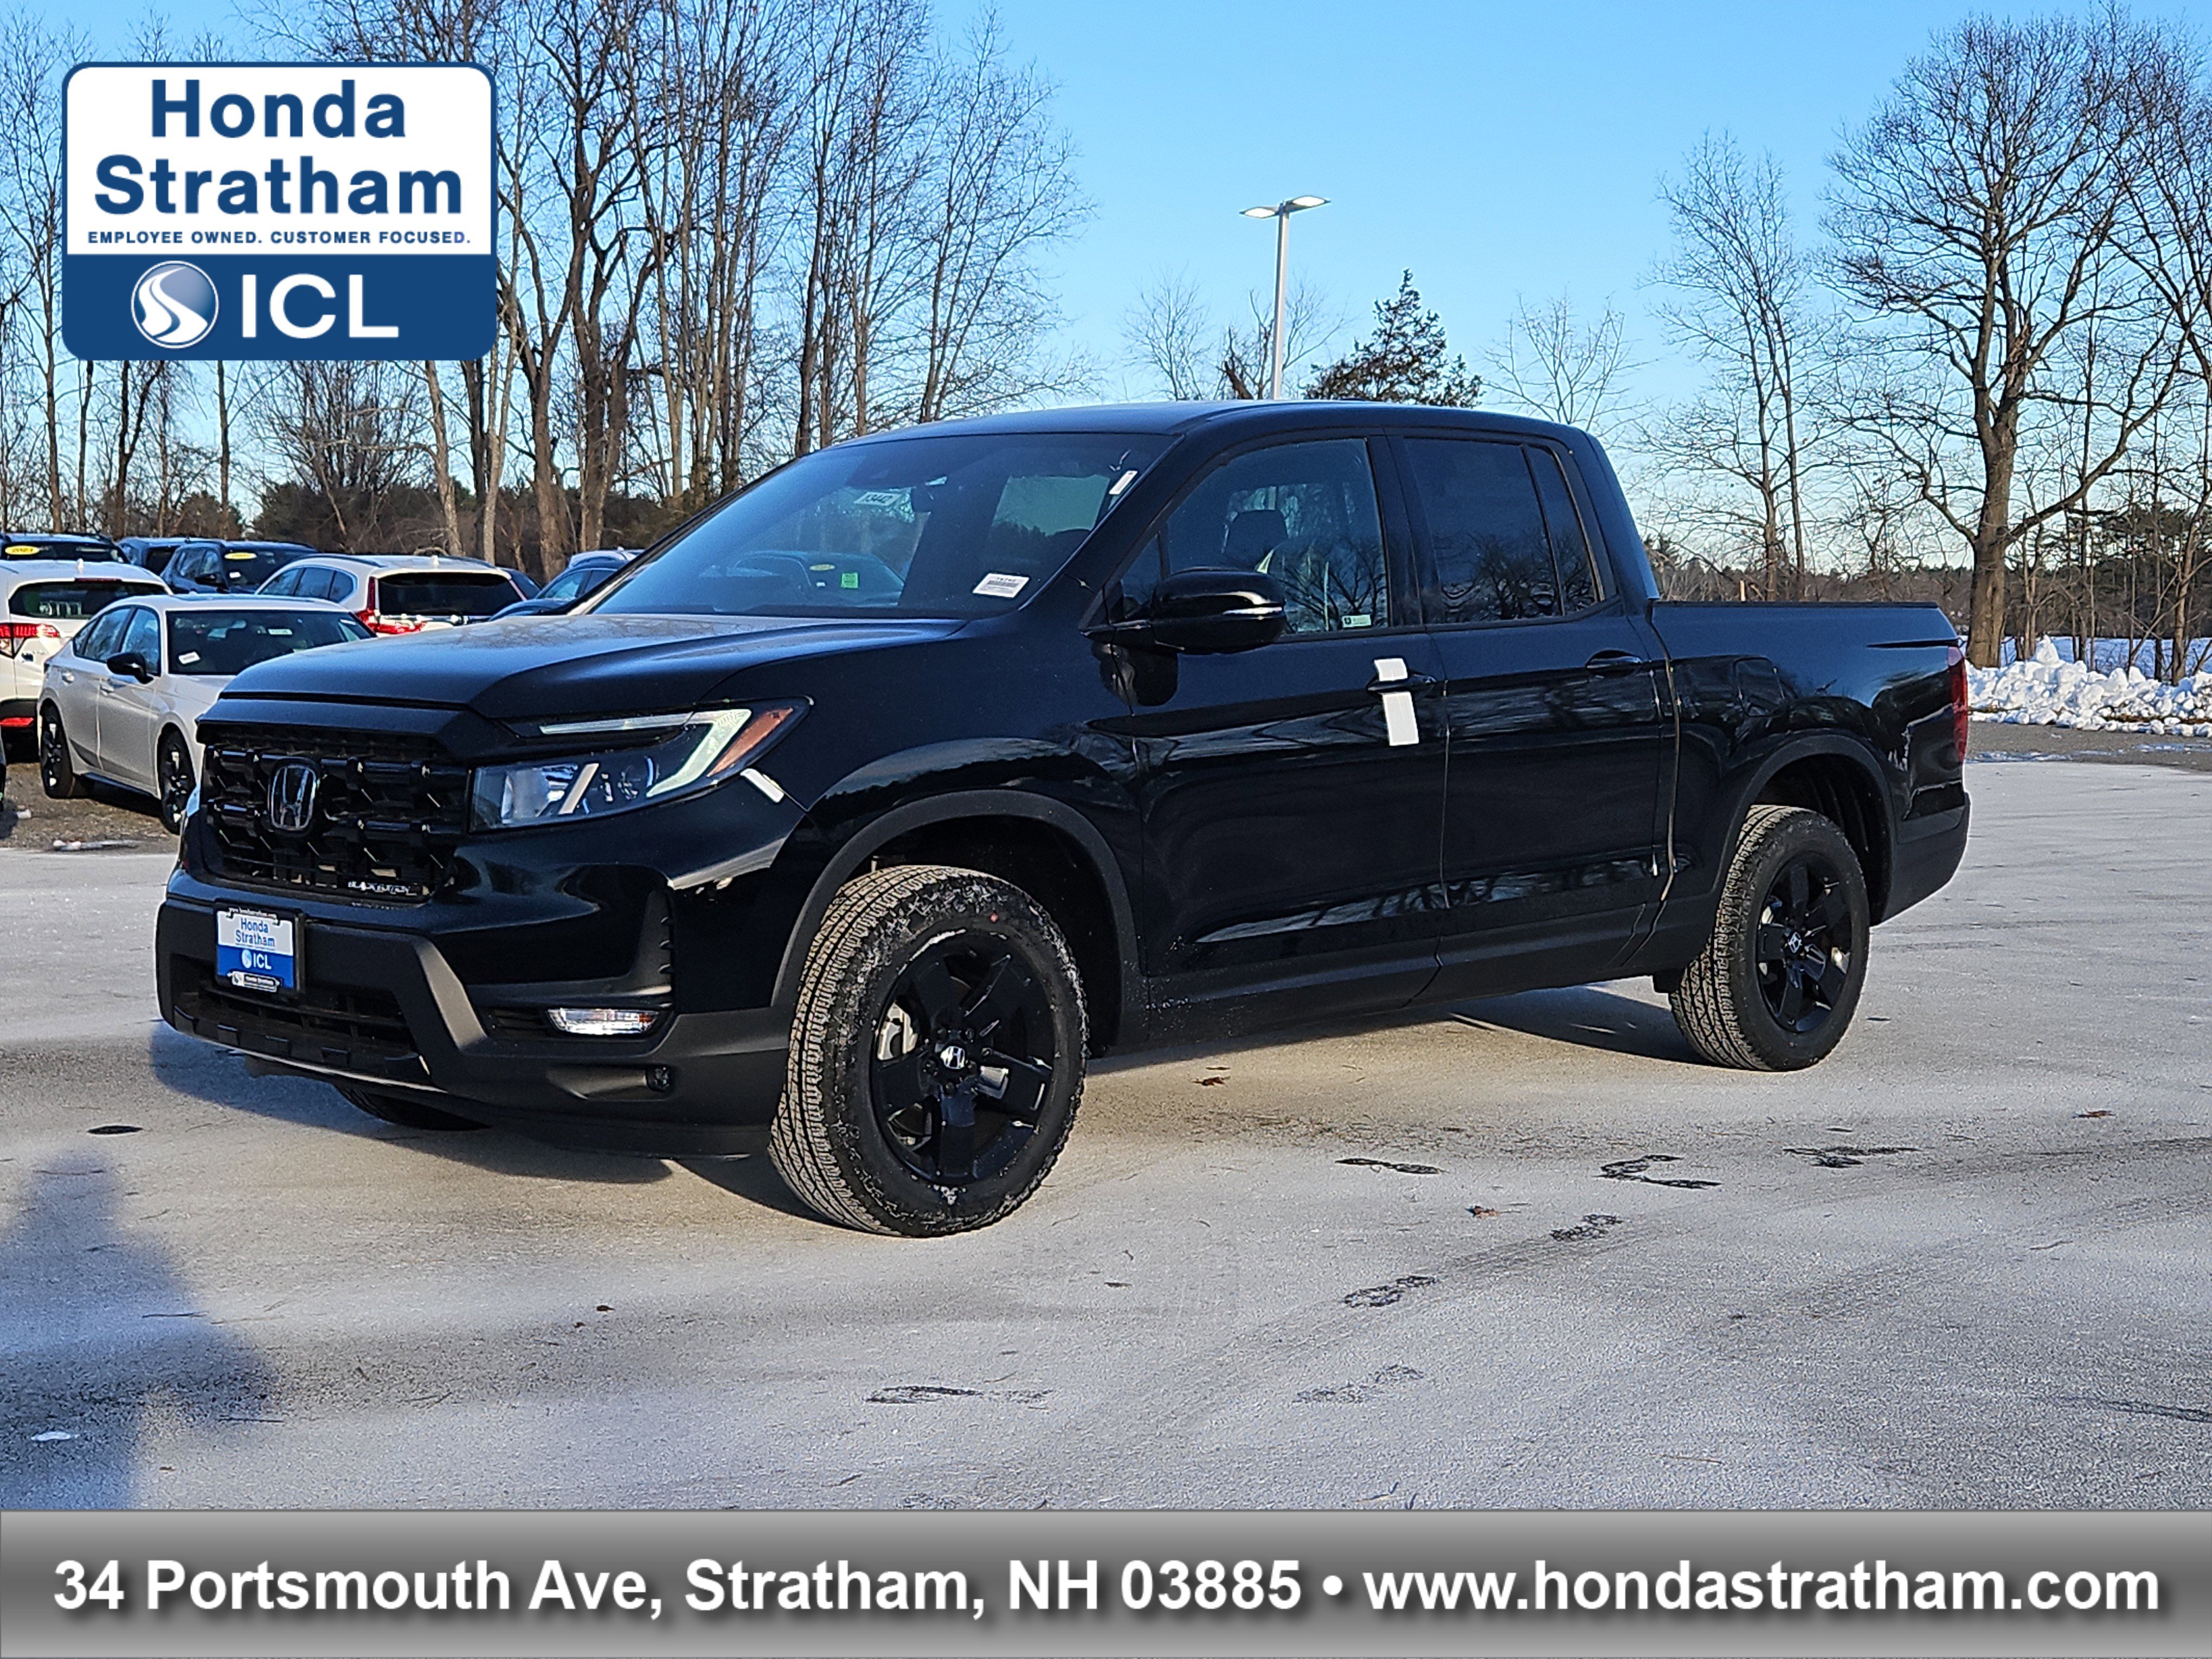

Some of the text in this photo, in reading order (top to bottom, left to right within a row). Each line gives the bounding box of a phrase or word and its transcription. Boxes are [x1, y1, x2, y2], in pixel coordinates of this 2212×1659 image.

[240, 917, 269, 934] Honda
[235, 929, 275, 947] Stratham
[253, 952, 272, 970] ICL
